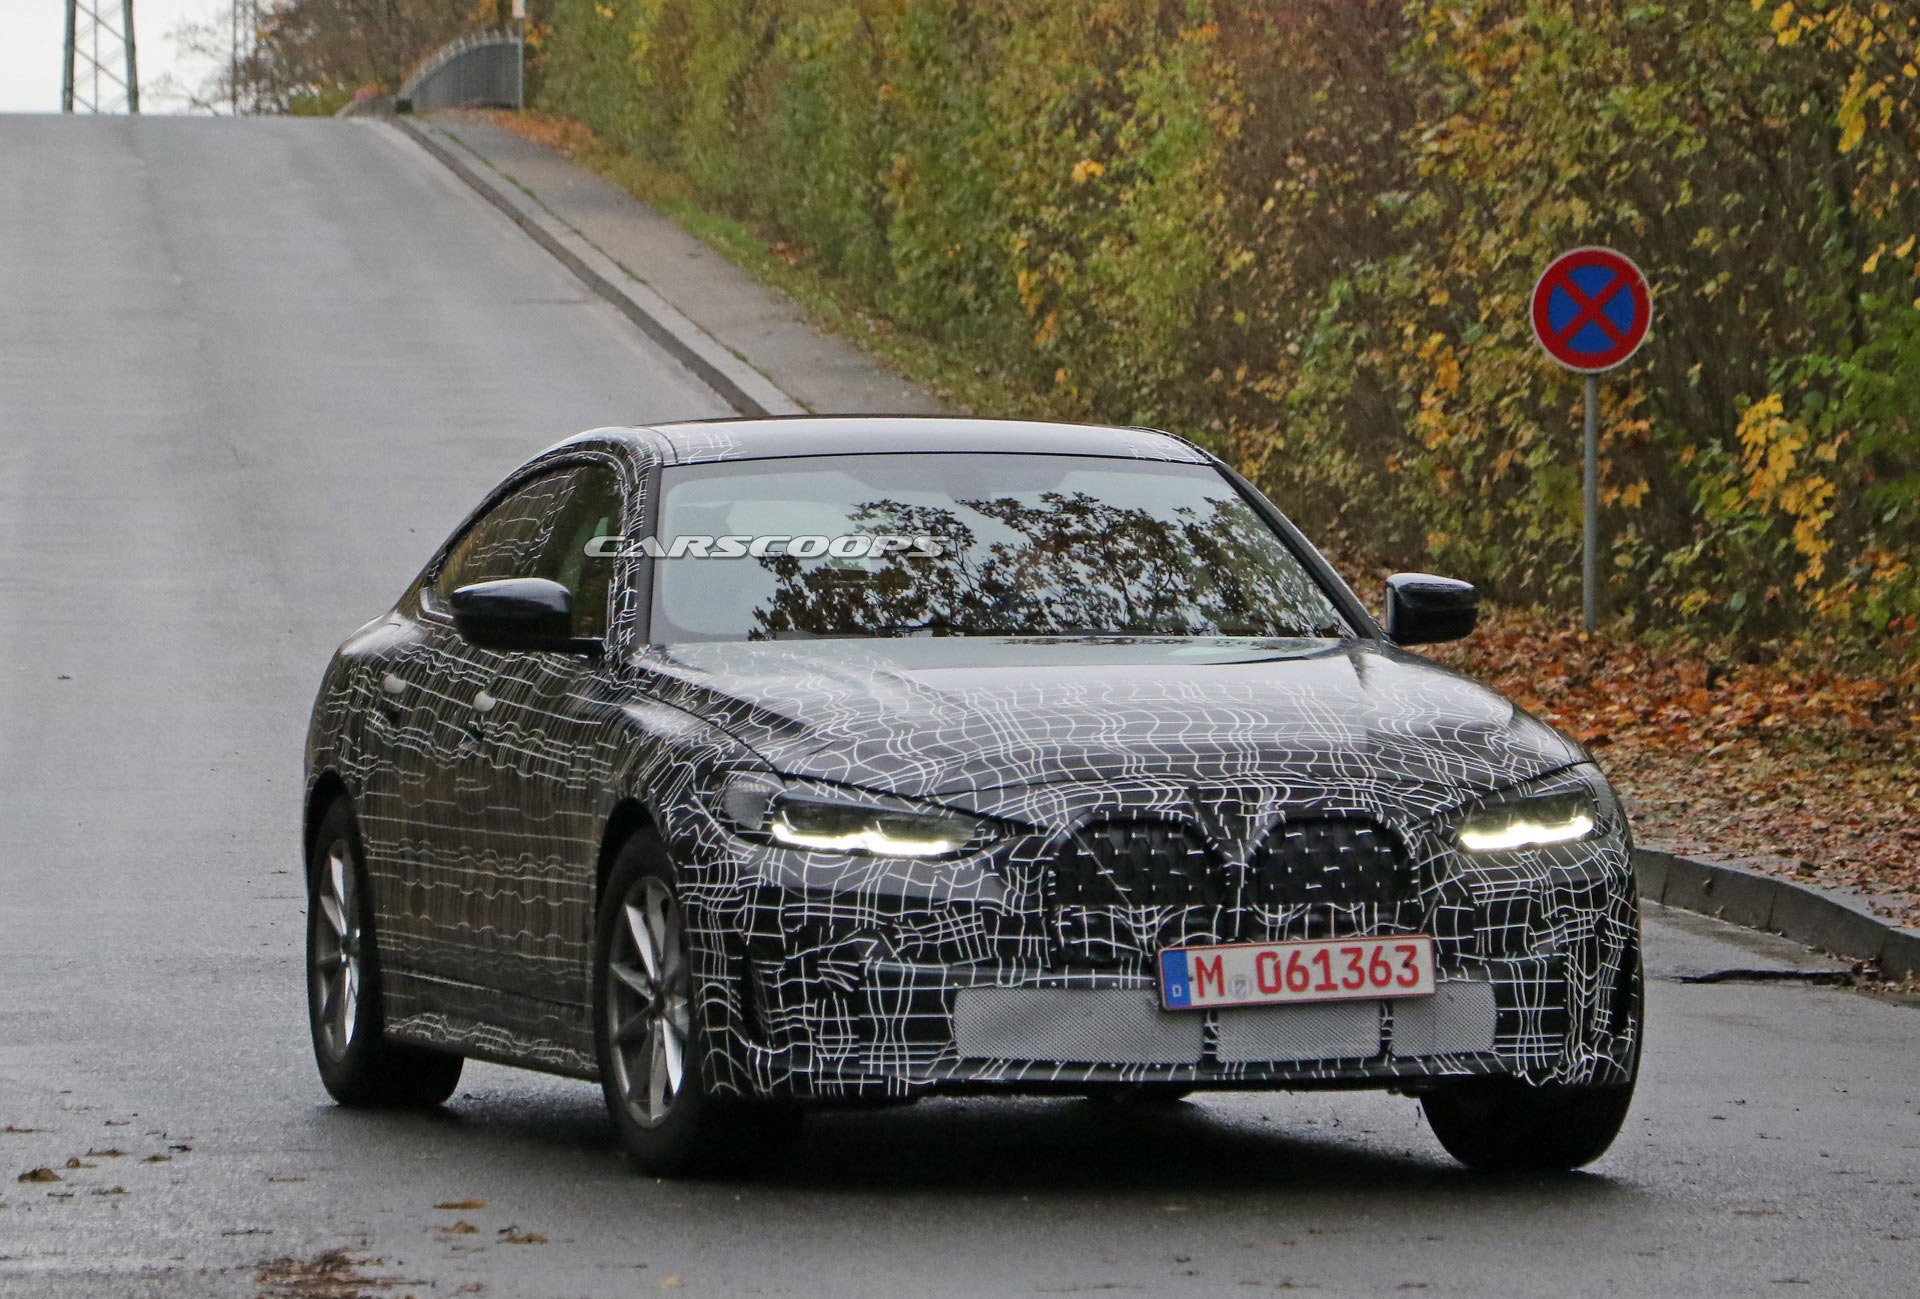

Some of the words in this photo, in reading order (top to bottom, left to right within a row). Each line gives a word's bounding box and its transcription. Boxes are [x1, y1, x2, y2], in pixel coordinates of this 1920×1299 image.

[1195, 955, 1225, 998] M
[1255, 944, 1420, 995] 061363
[1172, 985, 1182, 998] D
